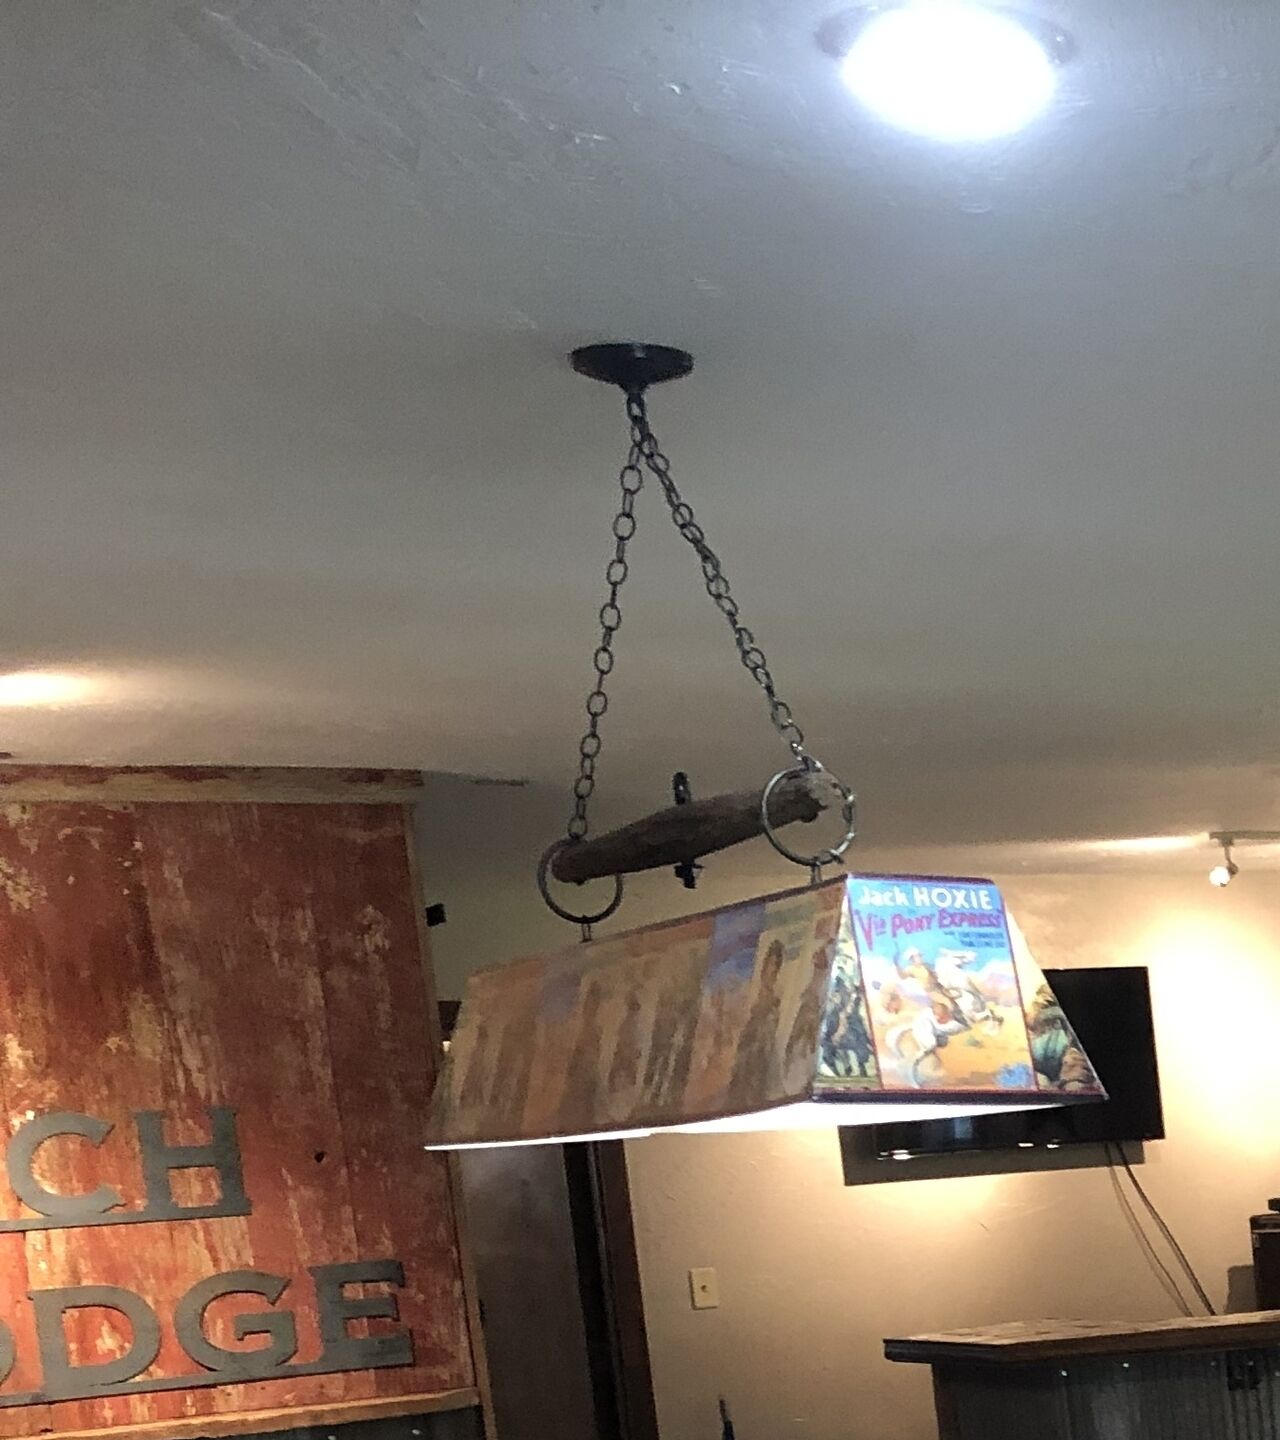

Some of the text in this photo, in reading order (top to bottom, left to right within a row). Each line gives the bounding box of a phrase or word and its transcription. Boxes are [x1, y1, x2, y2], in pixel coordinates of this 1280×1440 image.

[858, 885, 994, 910] Jack HOXIE
[0, 1258, 416, 1395] DGE
